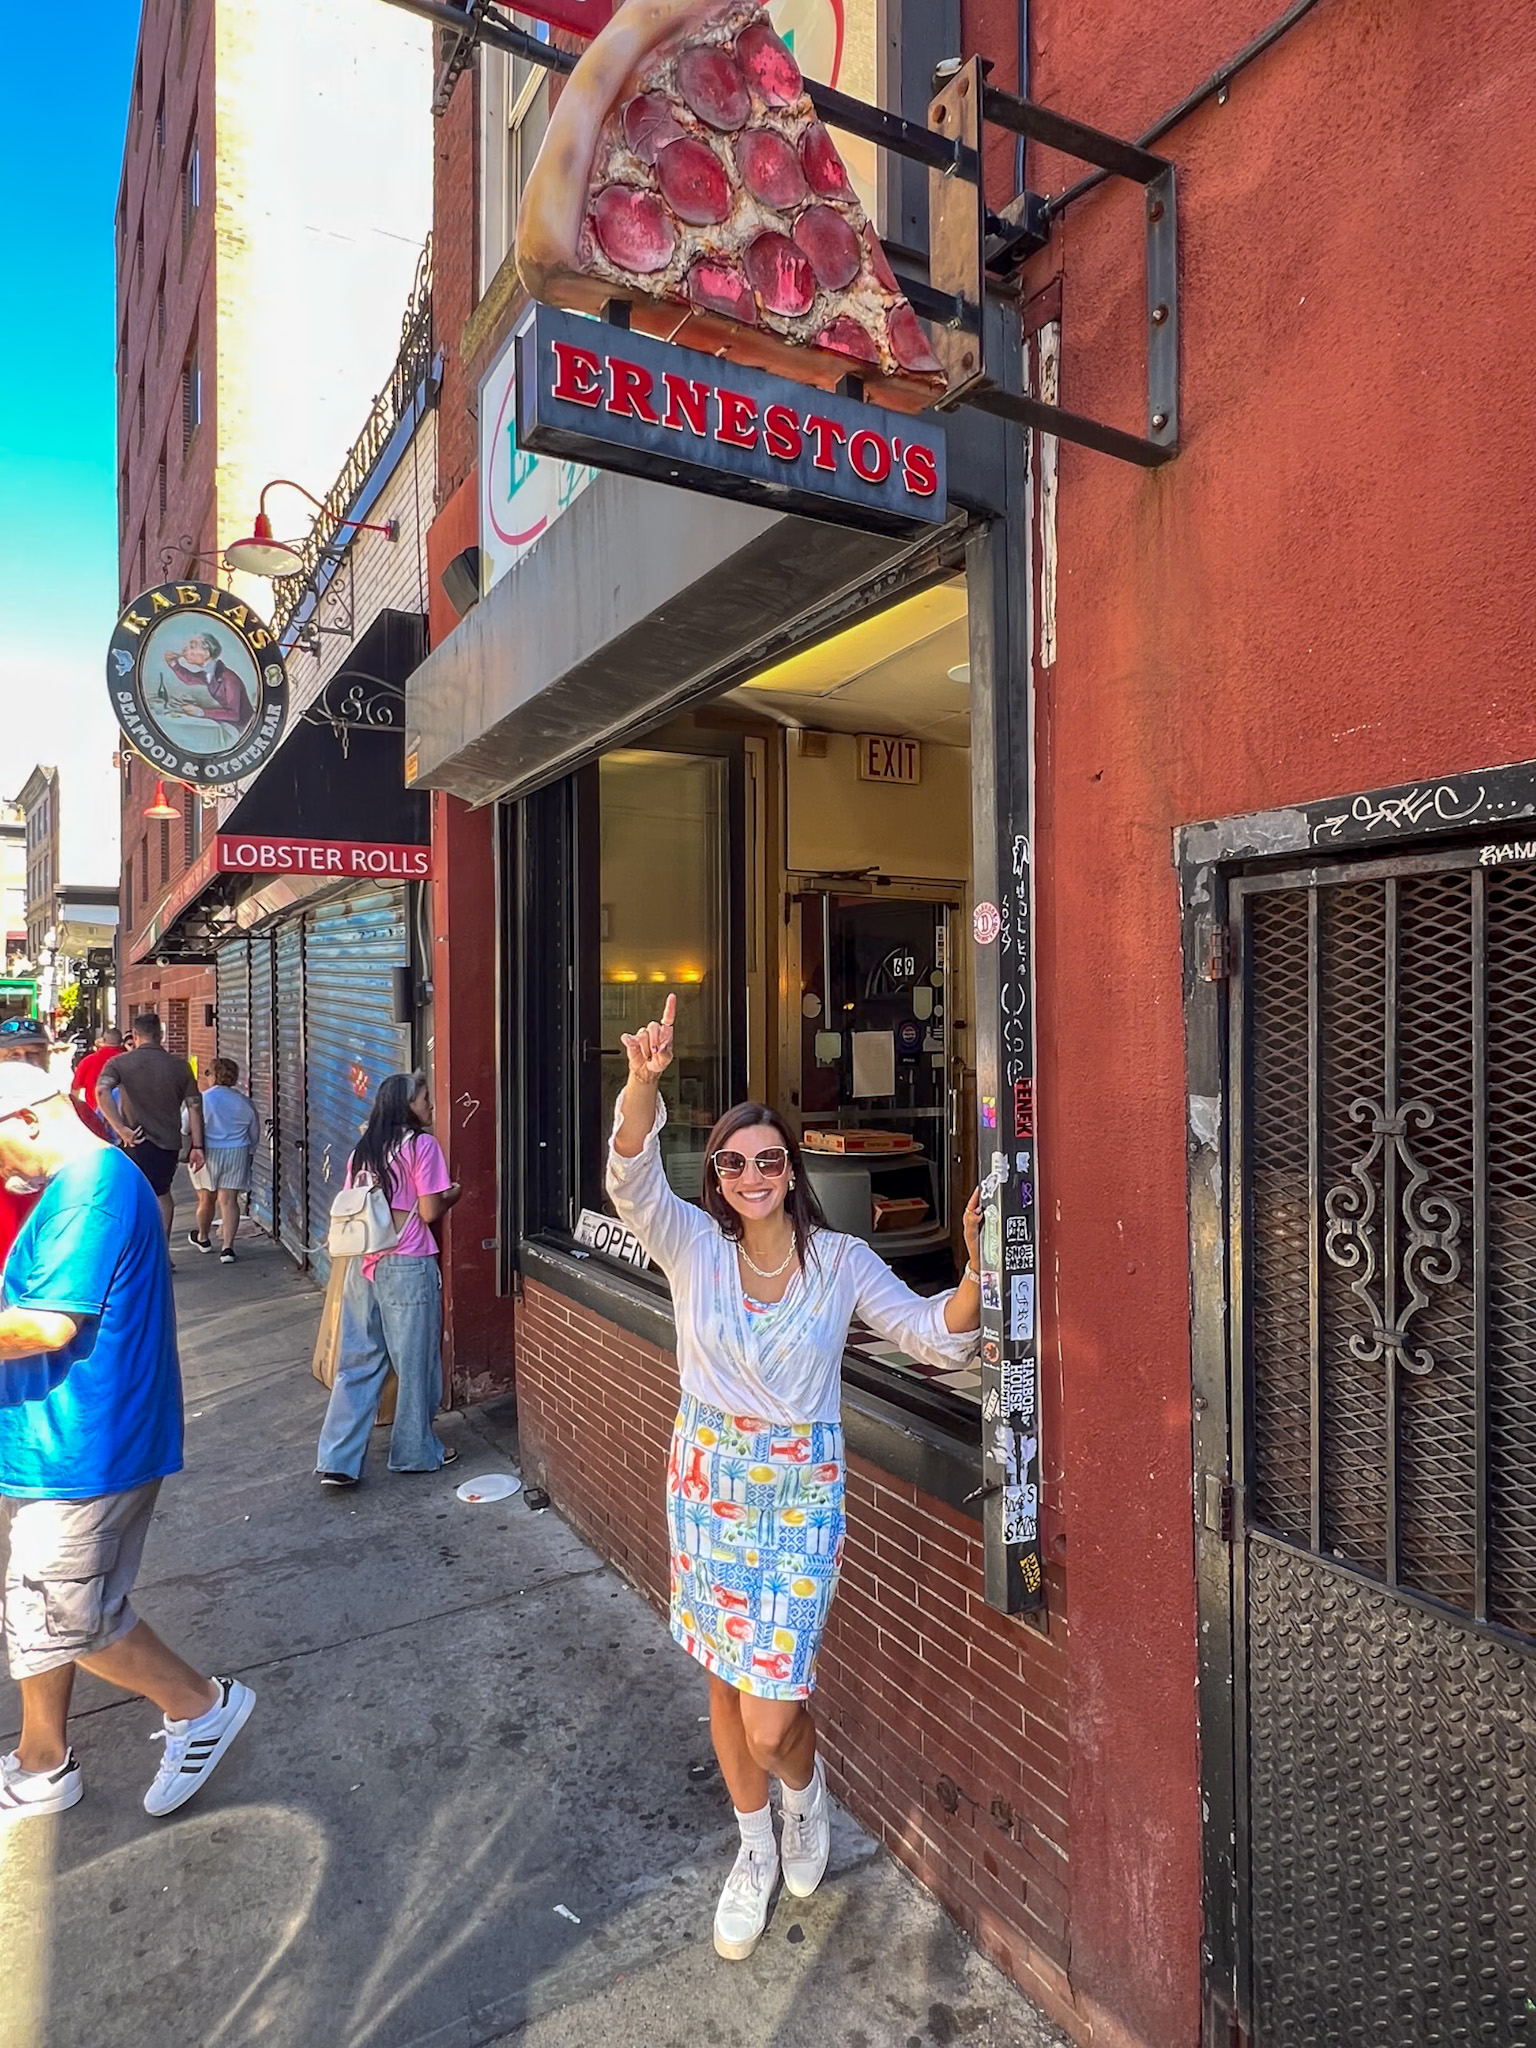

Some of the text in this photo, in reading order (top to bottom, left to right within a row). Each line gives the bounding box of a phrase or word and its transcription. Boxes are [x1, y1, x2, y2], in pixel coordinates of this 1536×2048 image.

[551, 340, 937, 497] ERNESTO'S
[121, 584, 273, 651] RABIA'S
[117, 691, 283, 779] SEAFOOD & OYSTER BAR
[868, 738, 916, 780] EXIT
[223, 843, 429, 874] LOBSTER ROLLS
[893, 956, 914, 976] 69
[594, 1222, 648, 1269] OPEN
[1000, 1360, 1011, 1418] COLLECTIVE
[1010, 1364, 1022, 1412] HOUSE
[1022, 1357, 1035, 1416] HARBOR
